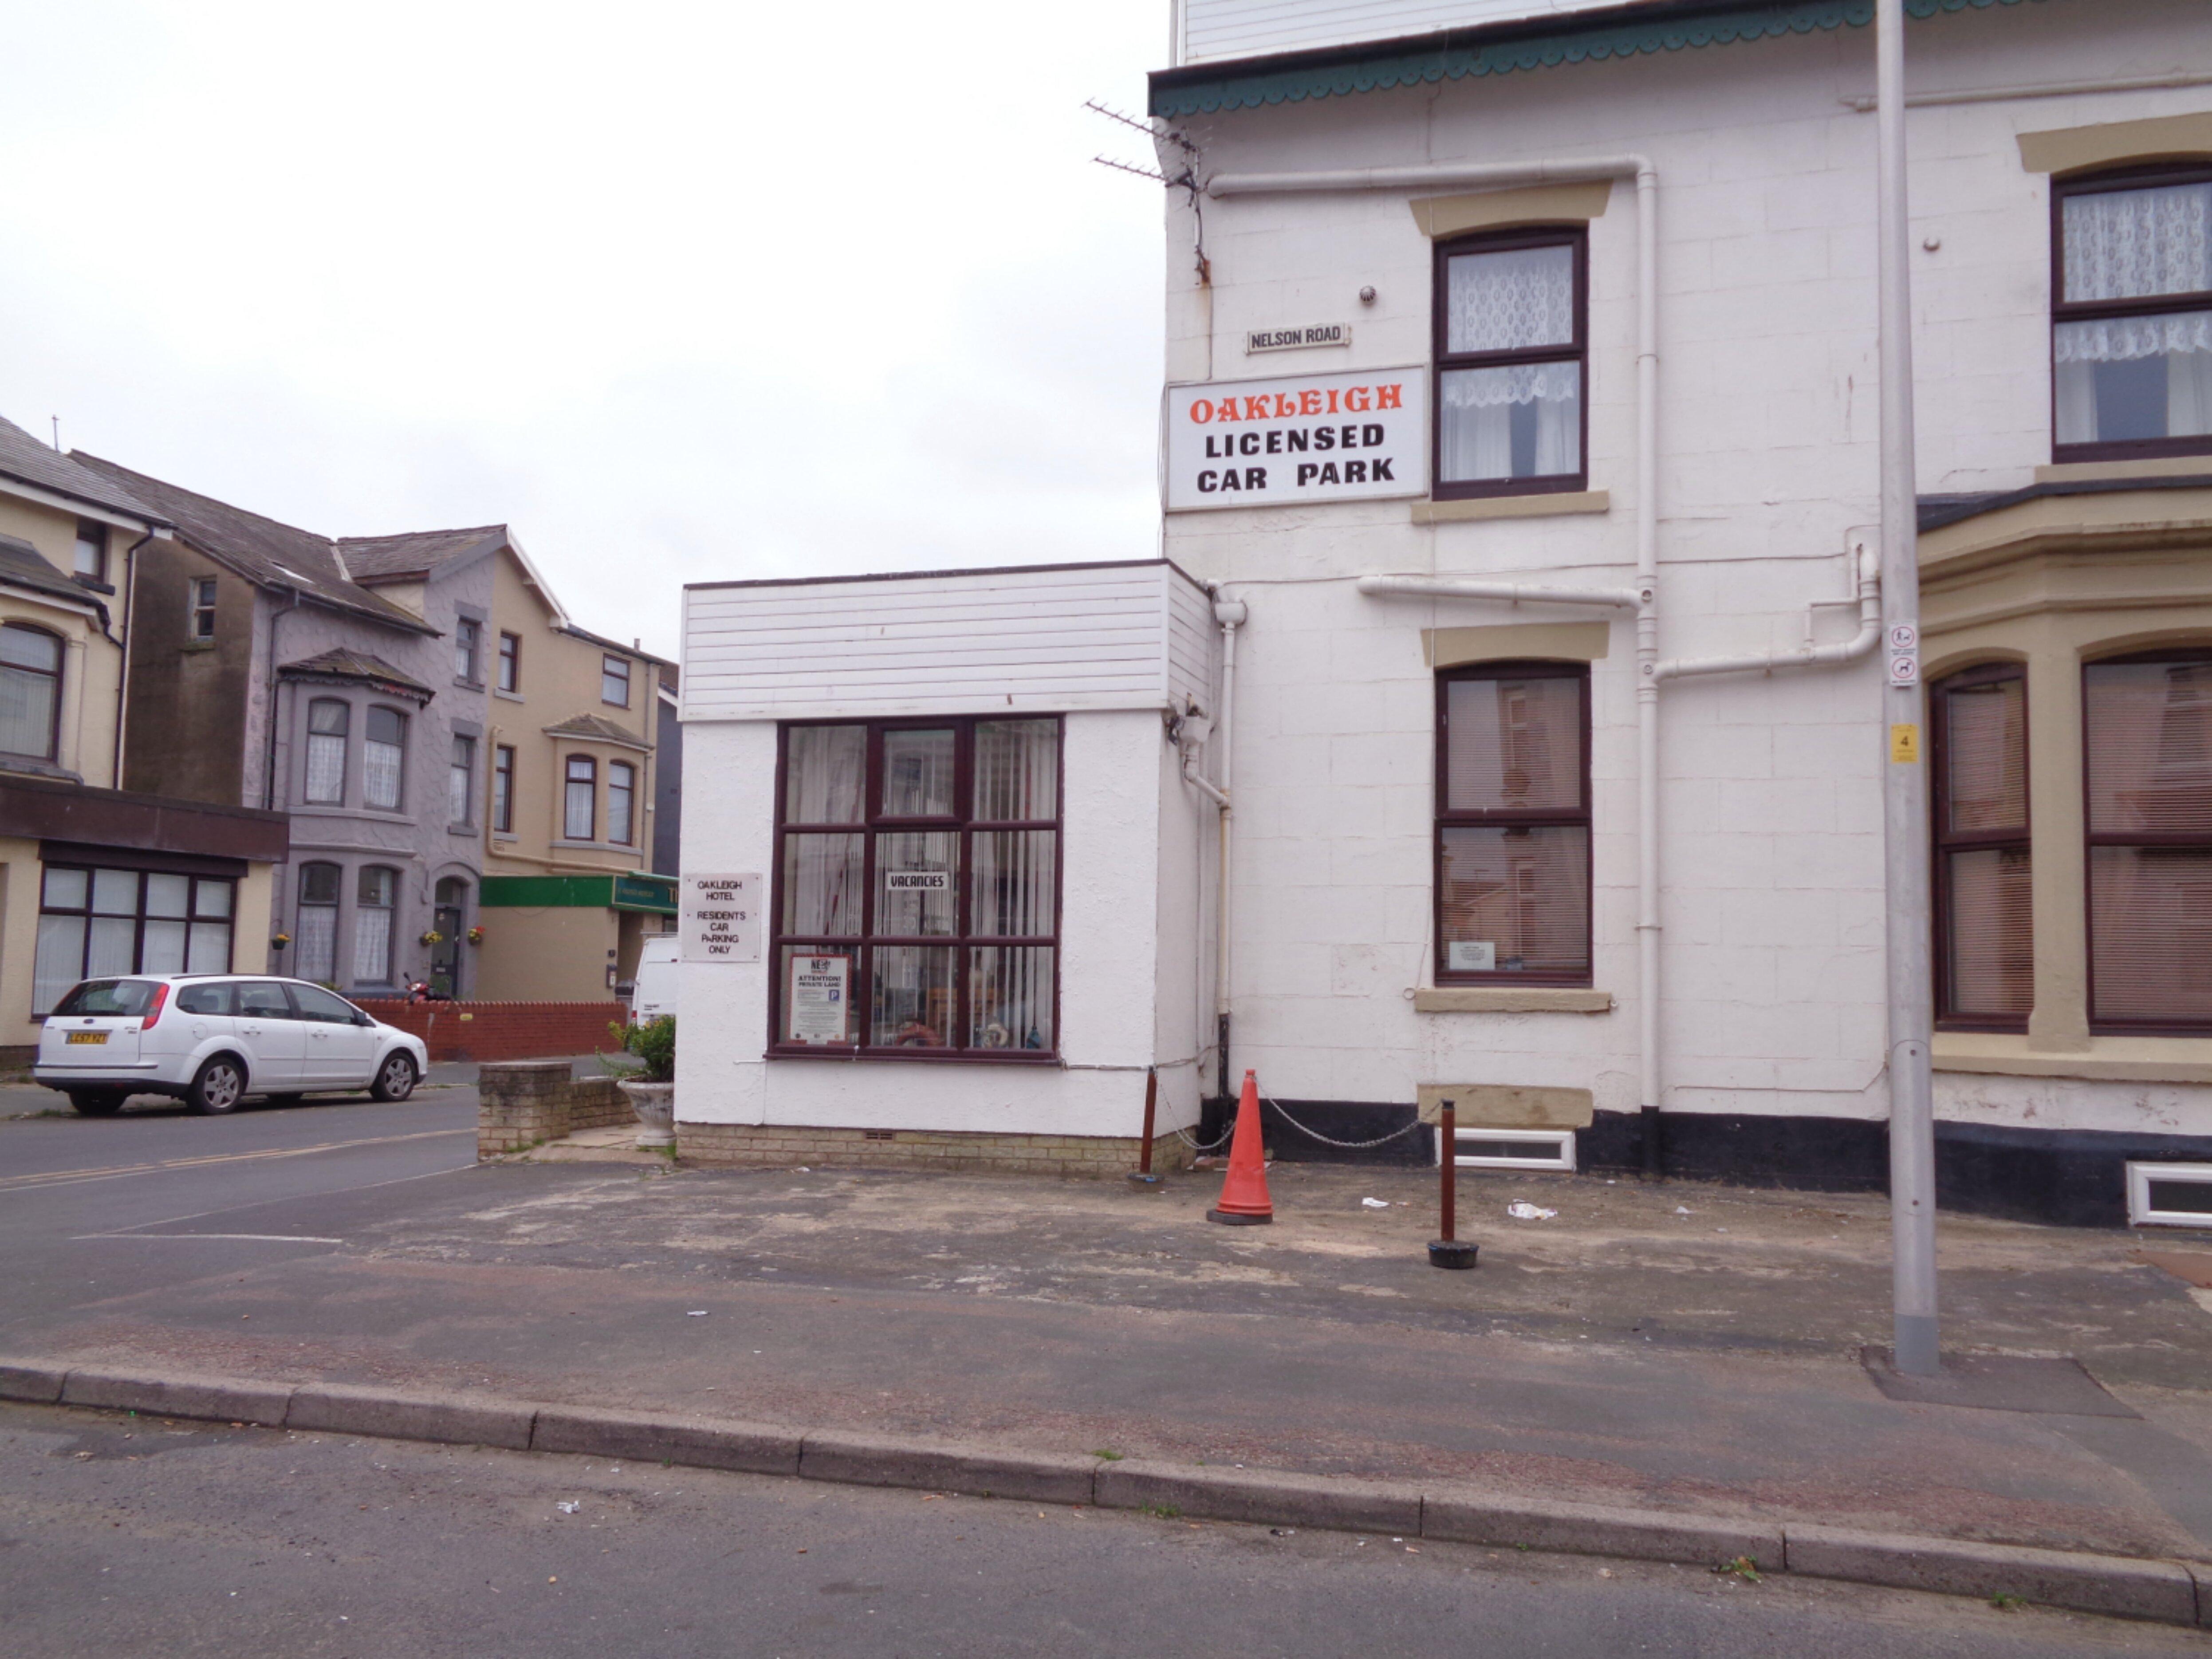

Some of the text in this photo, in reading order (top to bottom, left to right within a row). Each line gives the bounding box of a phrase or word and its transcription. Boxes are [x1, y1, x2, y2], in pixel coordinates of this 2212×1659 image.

[1252, 326, 1341, 348] NELSON ROAD
[1190, 384, 1402, 424] OAKLEIGH
[1206, 424, 1384, 458] LICENSED
[1198, 457, 1394, 492] CAR PARK
[1900, 736, 1909, 746] 4
[697, 880, 742, 889] OAKLEIGH
[891, 875, 944, 887] VACANCIES
[706, 892, 735, 900] HOTEL
[697, 911, 746, 920] RESIDENTS
[710, 922, 729, 931] CAR
[701, 934, 739, 943] PARKING
[709, 945, 730, 954] ONLY
